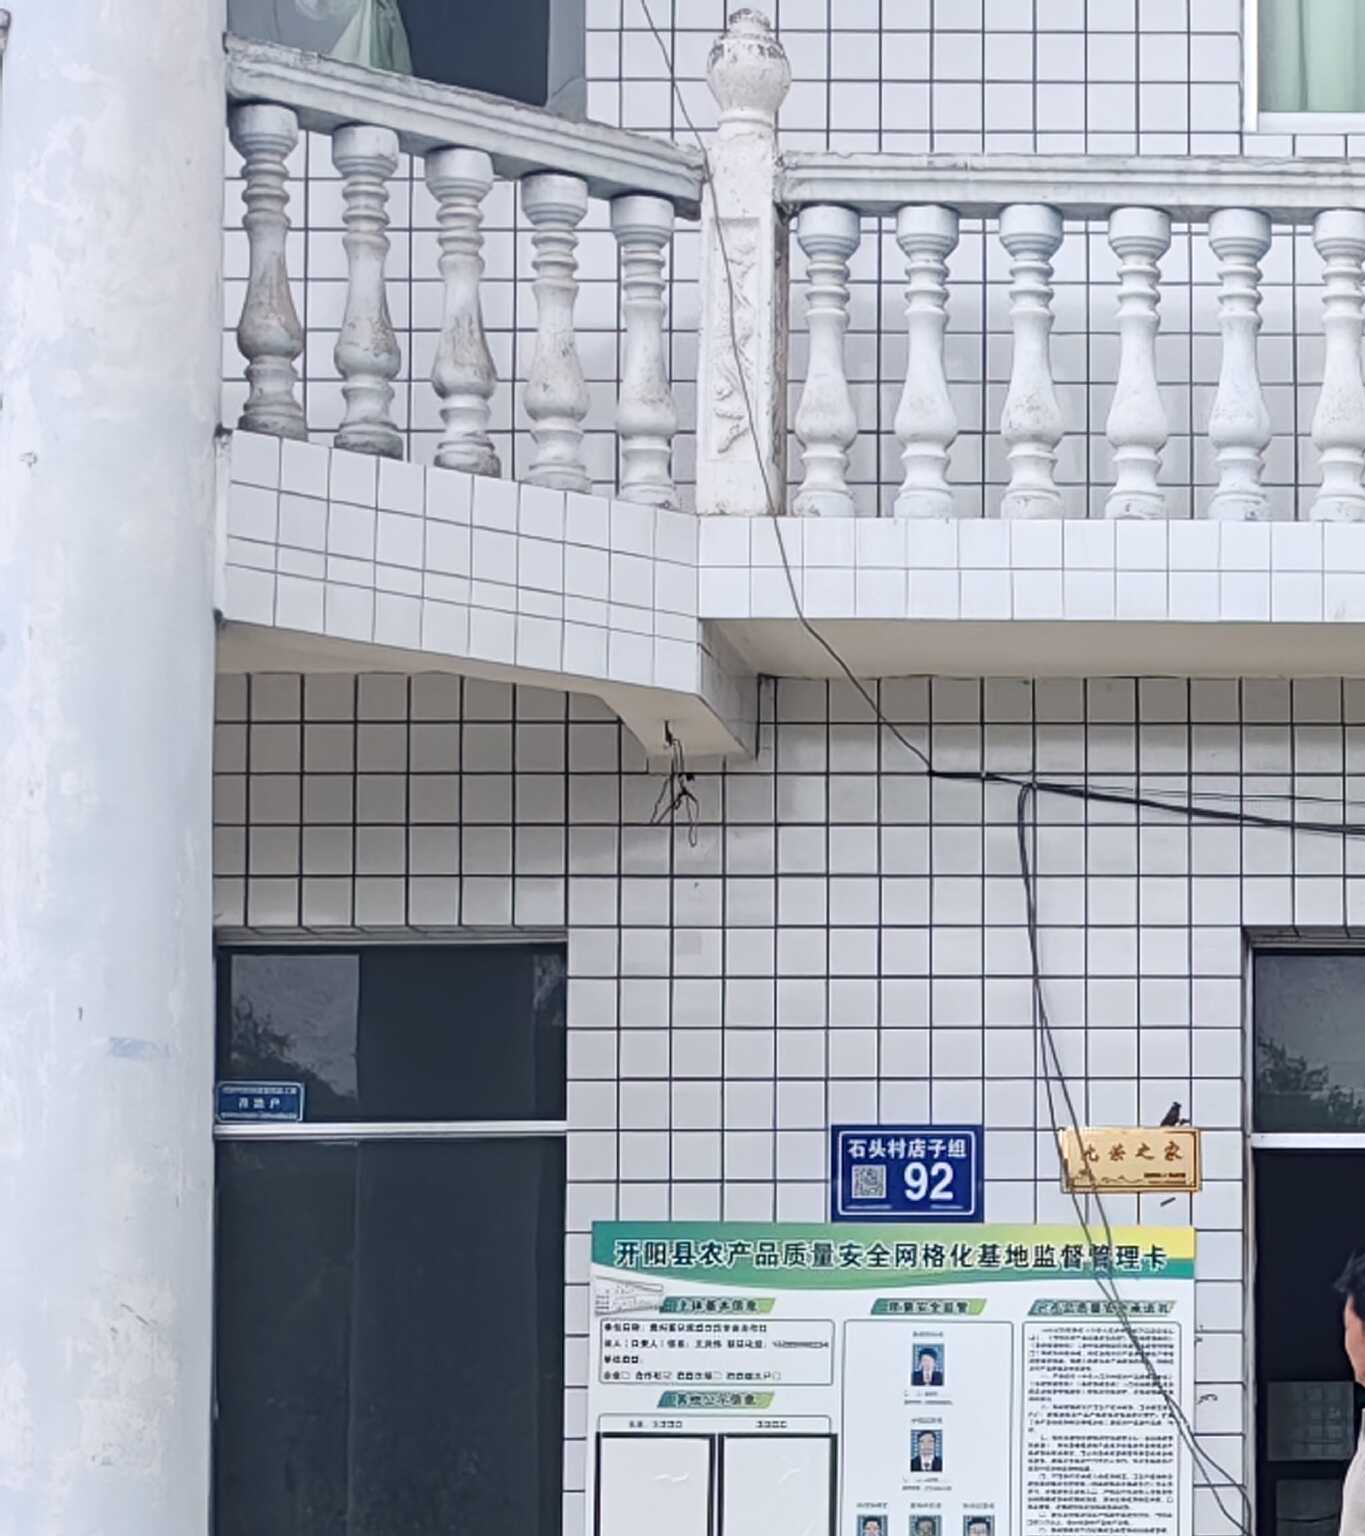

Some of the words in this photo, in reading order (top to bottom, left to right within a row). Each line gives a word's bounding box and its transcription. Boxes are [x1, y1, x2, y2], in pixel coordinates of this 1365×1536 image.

[848, 1137, 967, 1159] 石头村店子组
[903, 1161, 954, 1202] 92
[614, 1238, 1169, 1273] 开阳县农产品质量安全网格化基地监督管理卡
